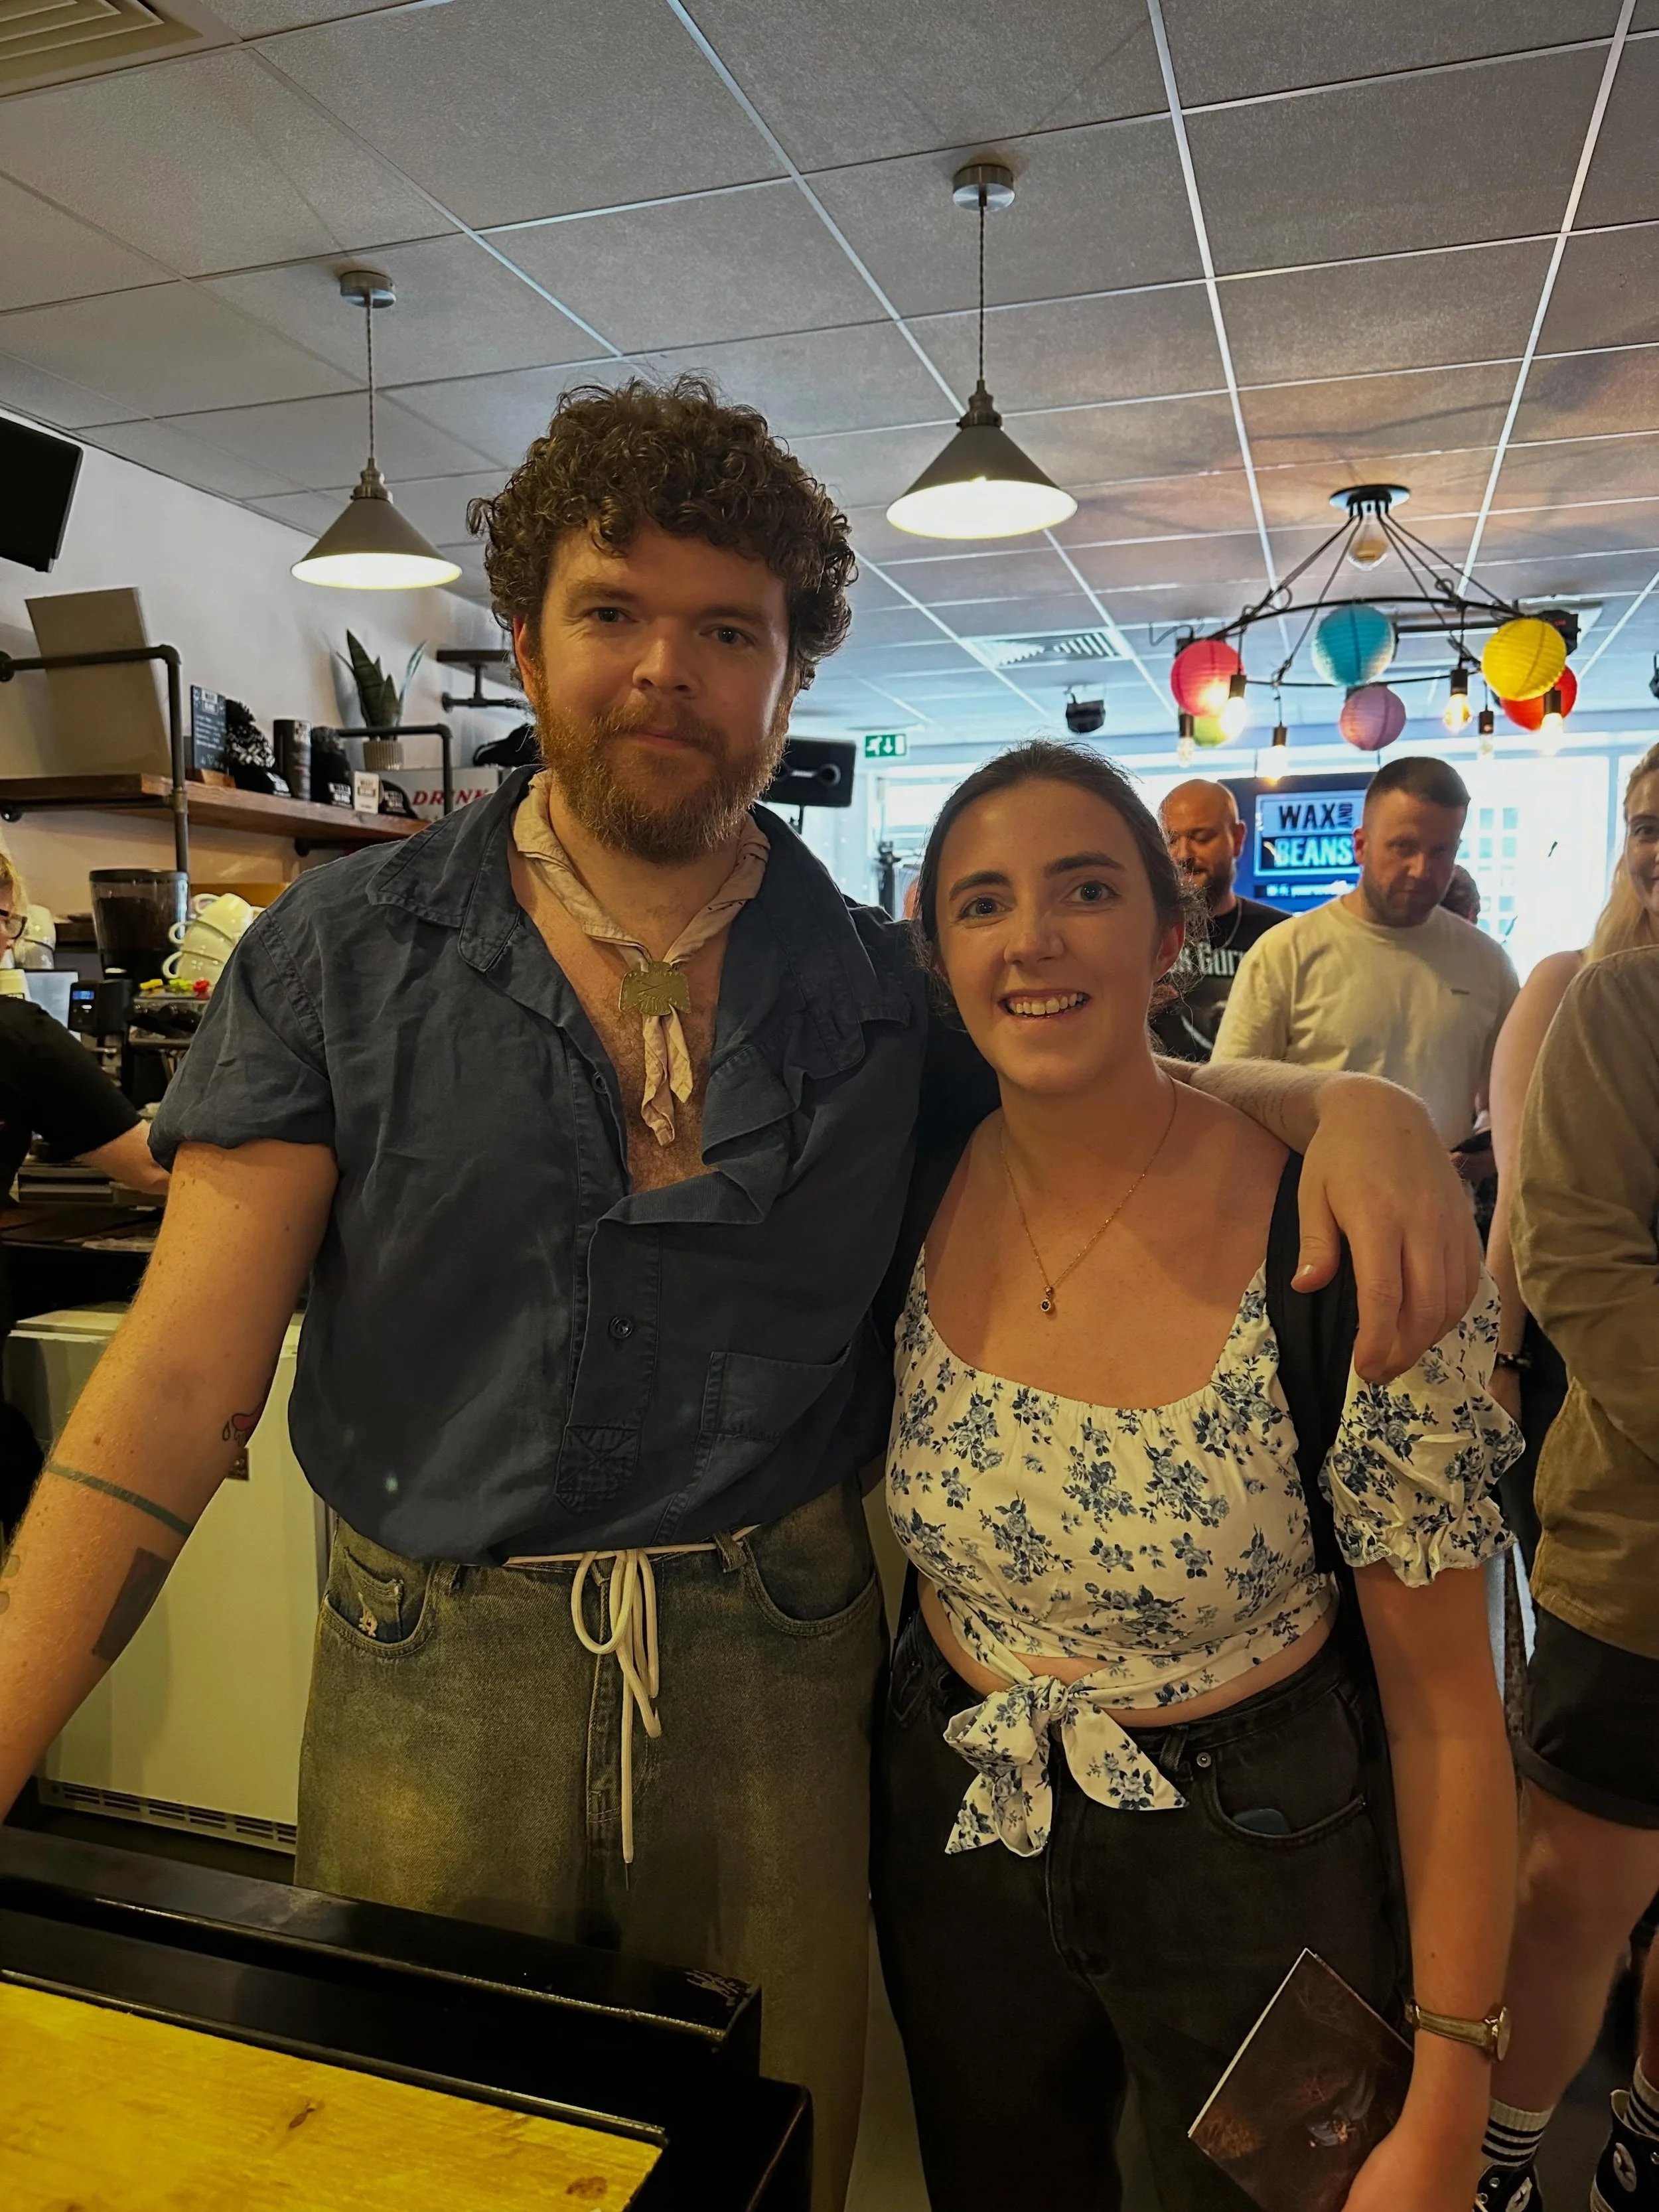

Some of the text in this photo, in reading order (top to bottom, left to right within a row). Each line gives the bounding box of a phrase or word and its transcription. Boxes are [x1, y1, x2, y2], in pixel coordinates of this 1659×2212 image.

[411, 789, 488, 806] DRN
[1279, 802, 1335, 830] WAX
[1274, 836, 1354, 868] BEANS
